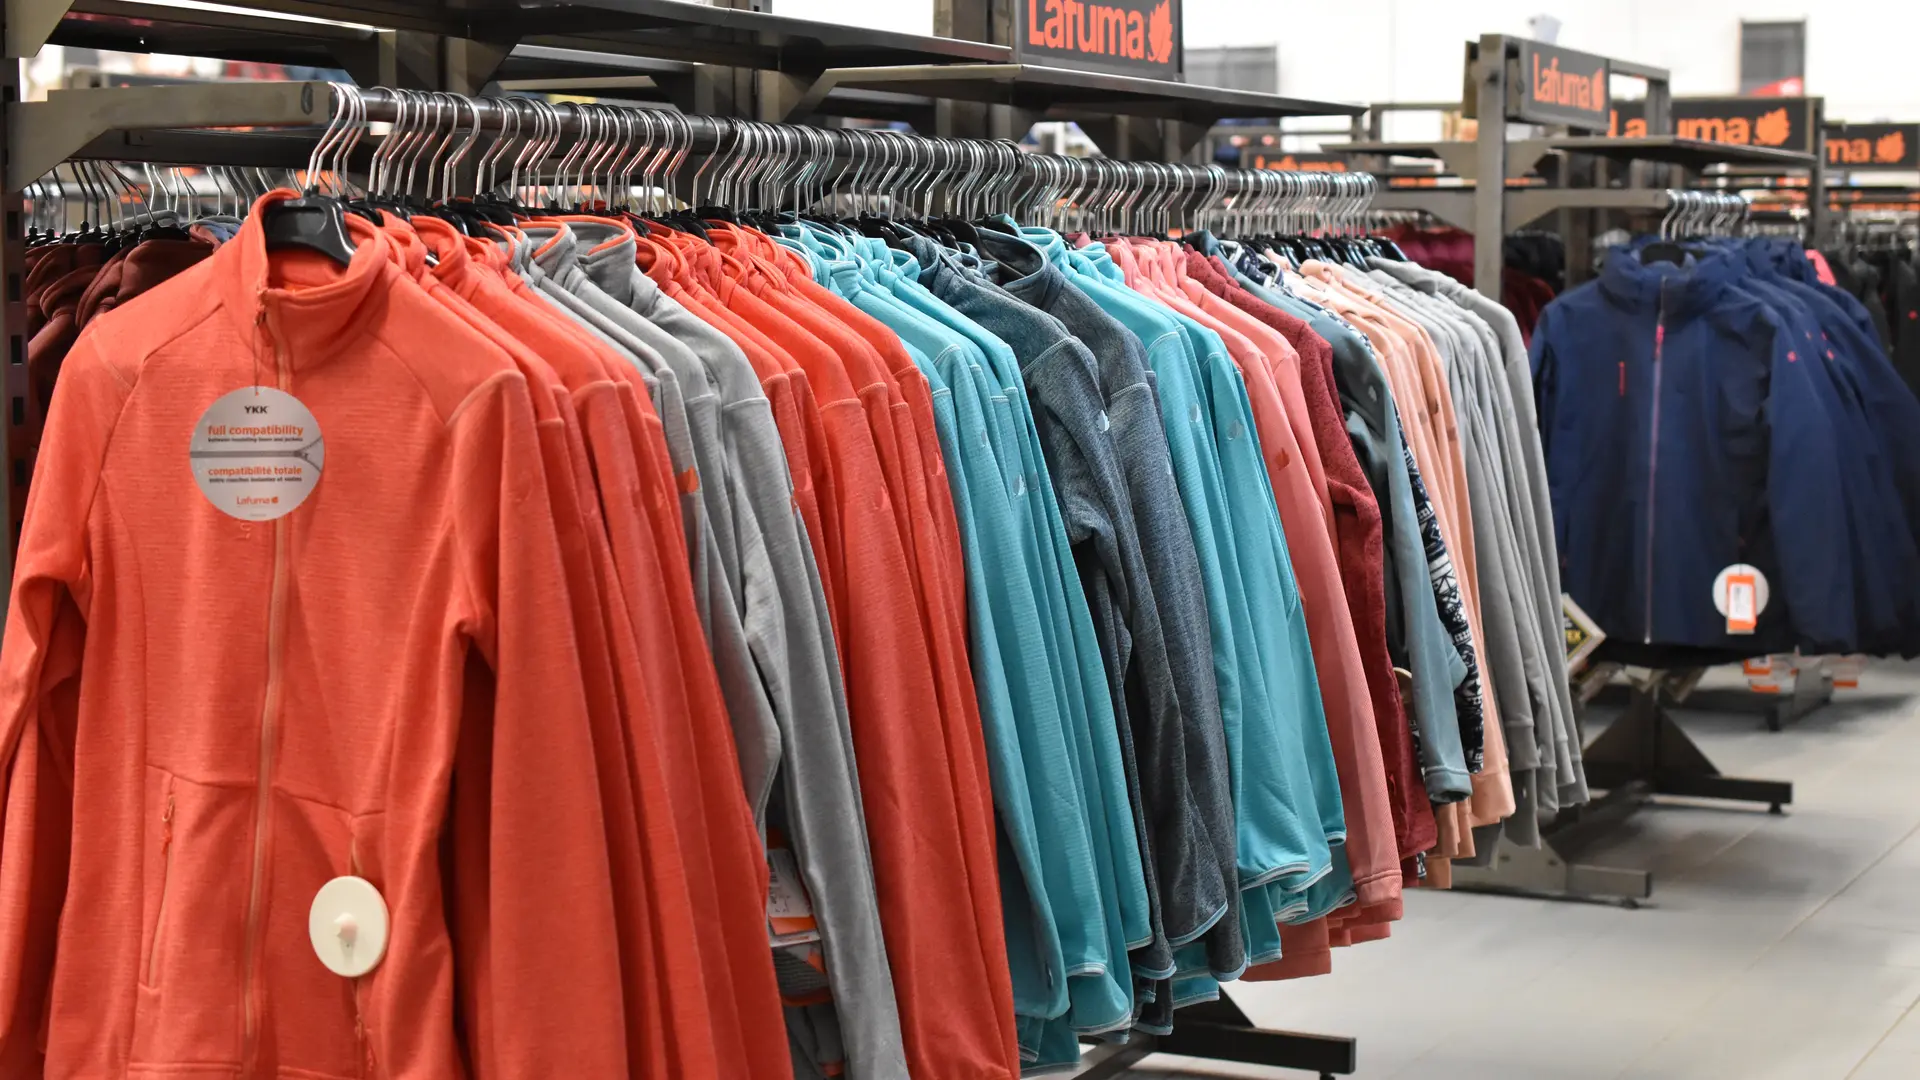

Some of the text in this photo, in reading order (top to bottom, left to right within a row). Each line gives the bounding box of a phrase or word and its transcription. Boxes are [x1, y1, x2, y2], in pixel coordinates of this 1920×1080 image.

[1028, 0, 1145, 60] Lafuma
[1533, 52, 1591, 110] Lafuma
[244, 405, 269, 414] YKK
[207, 425, 304, 437] full compatibility
[274, 465, 302, 476] totale
[236, 495, 270, 506] Lafuma
